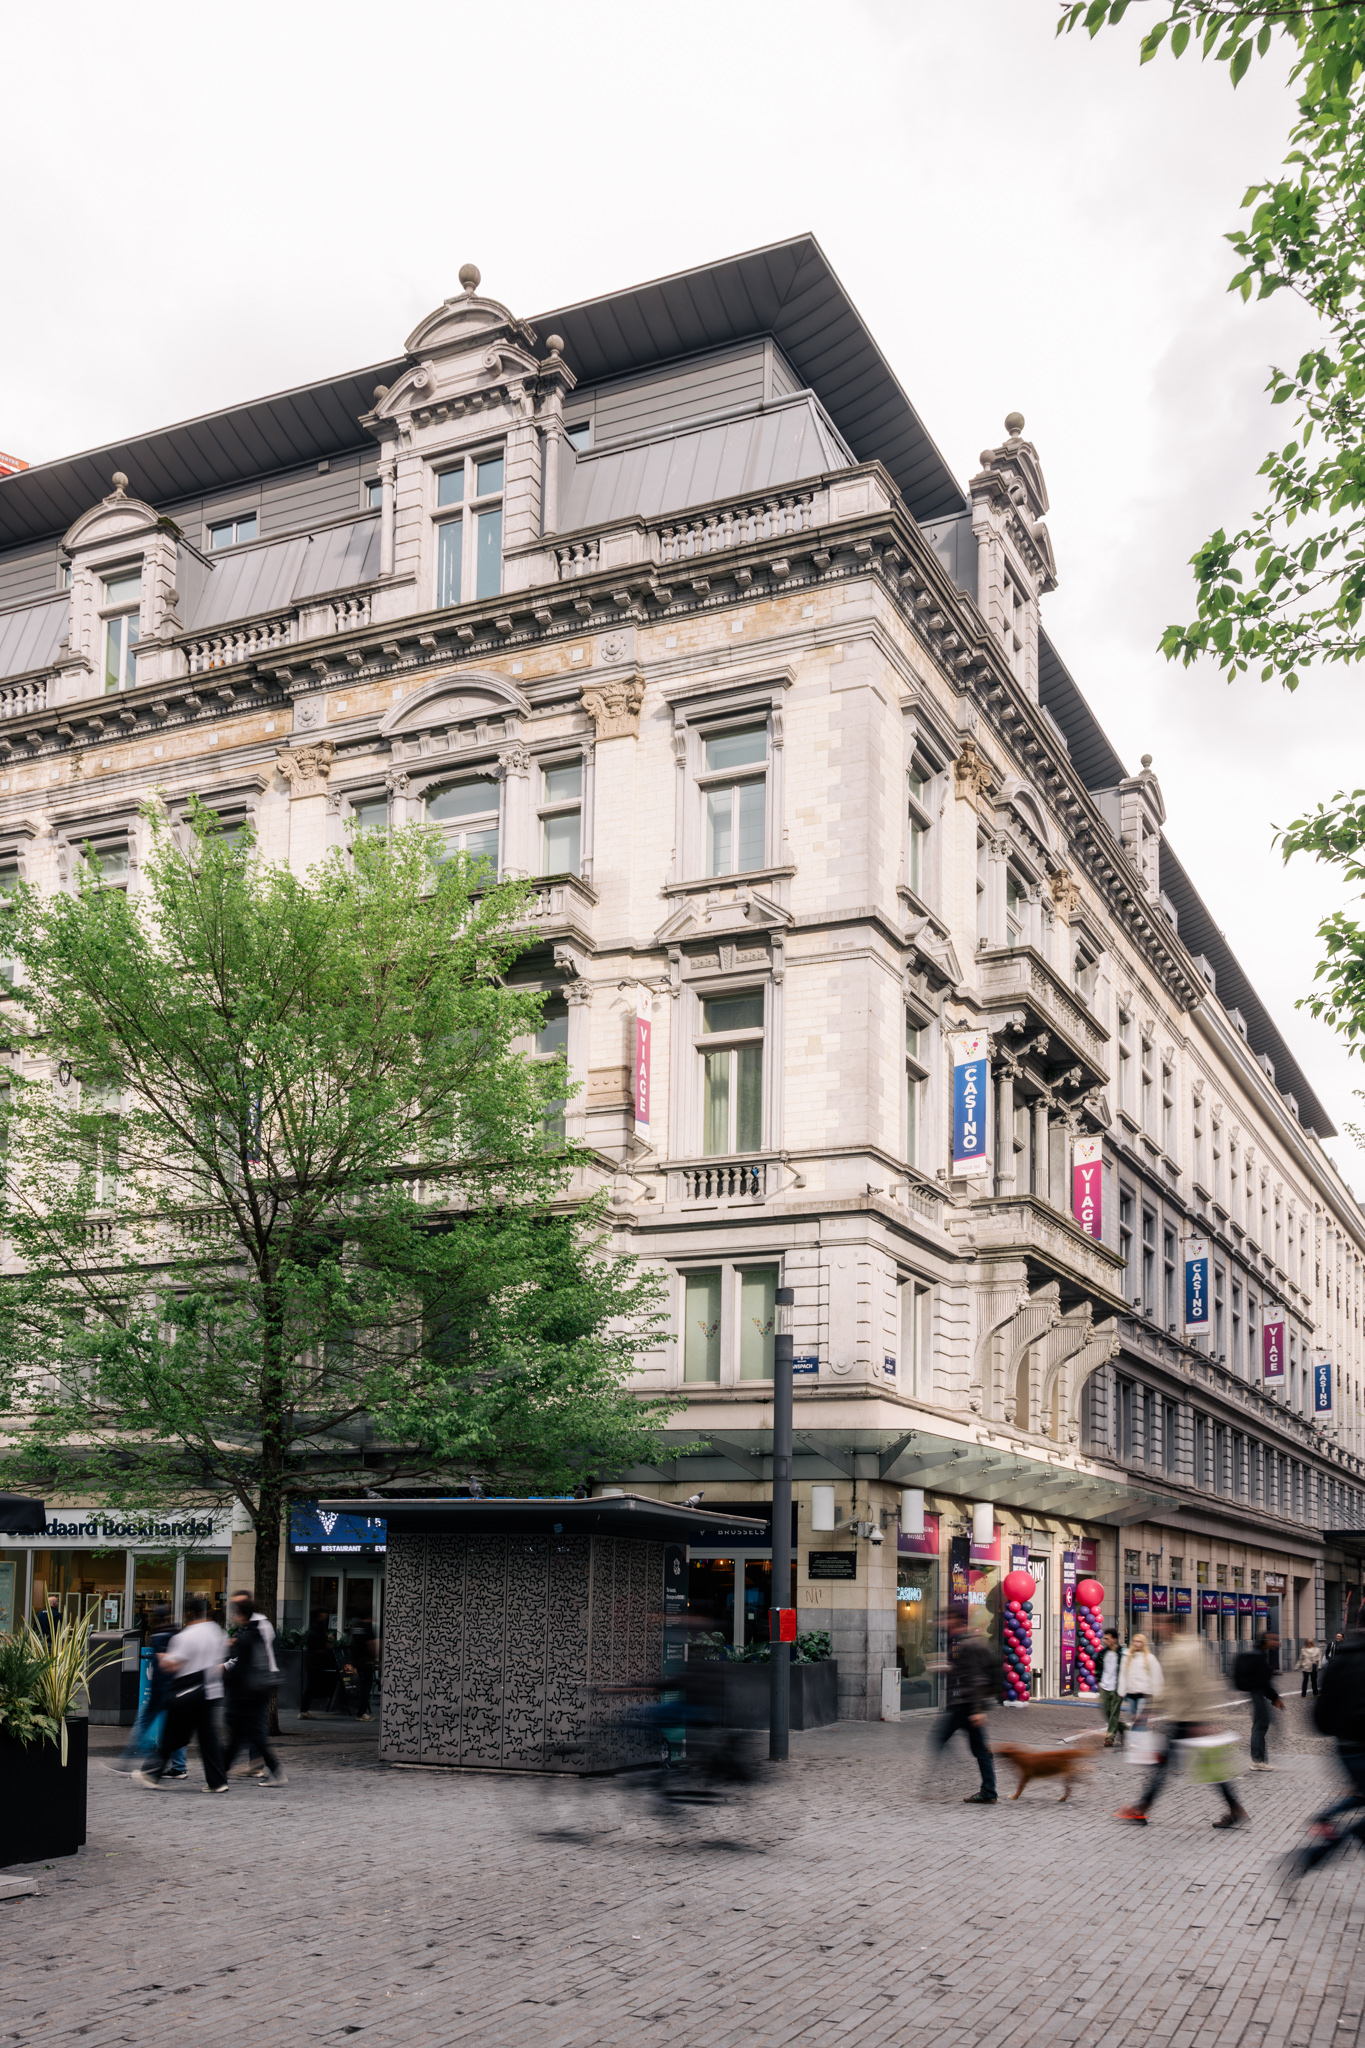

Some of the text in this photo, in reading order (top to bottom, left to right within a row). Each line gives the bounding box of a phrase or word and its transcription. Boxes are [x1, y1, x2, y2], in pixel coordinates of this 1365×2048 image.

[639, 1025, 648, 1113] VIAGE
[963, 1068, 978, 1149] CASINO
[1081, 1168, 1094, 1234] VIAGE
[1192, 1263, 1203, 1317] CASINO
[1268, 1327, 1278, 1371] VIAGE
[1319, 1367, 1328, 1406] CASINO
[7, 1518, 98, 1537] daard
